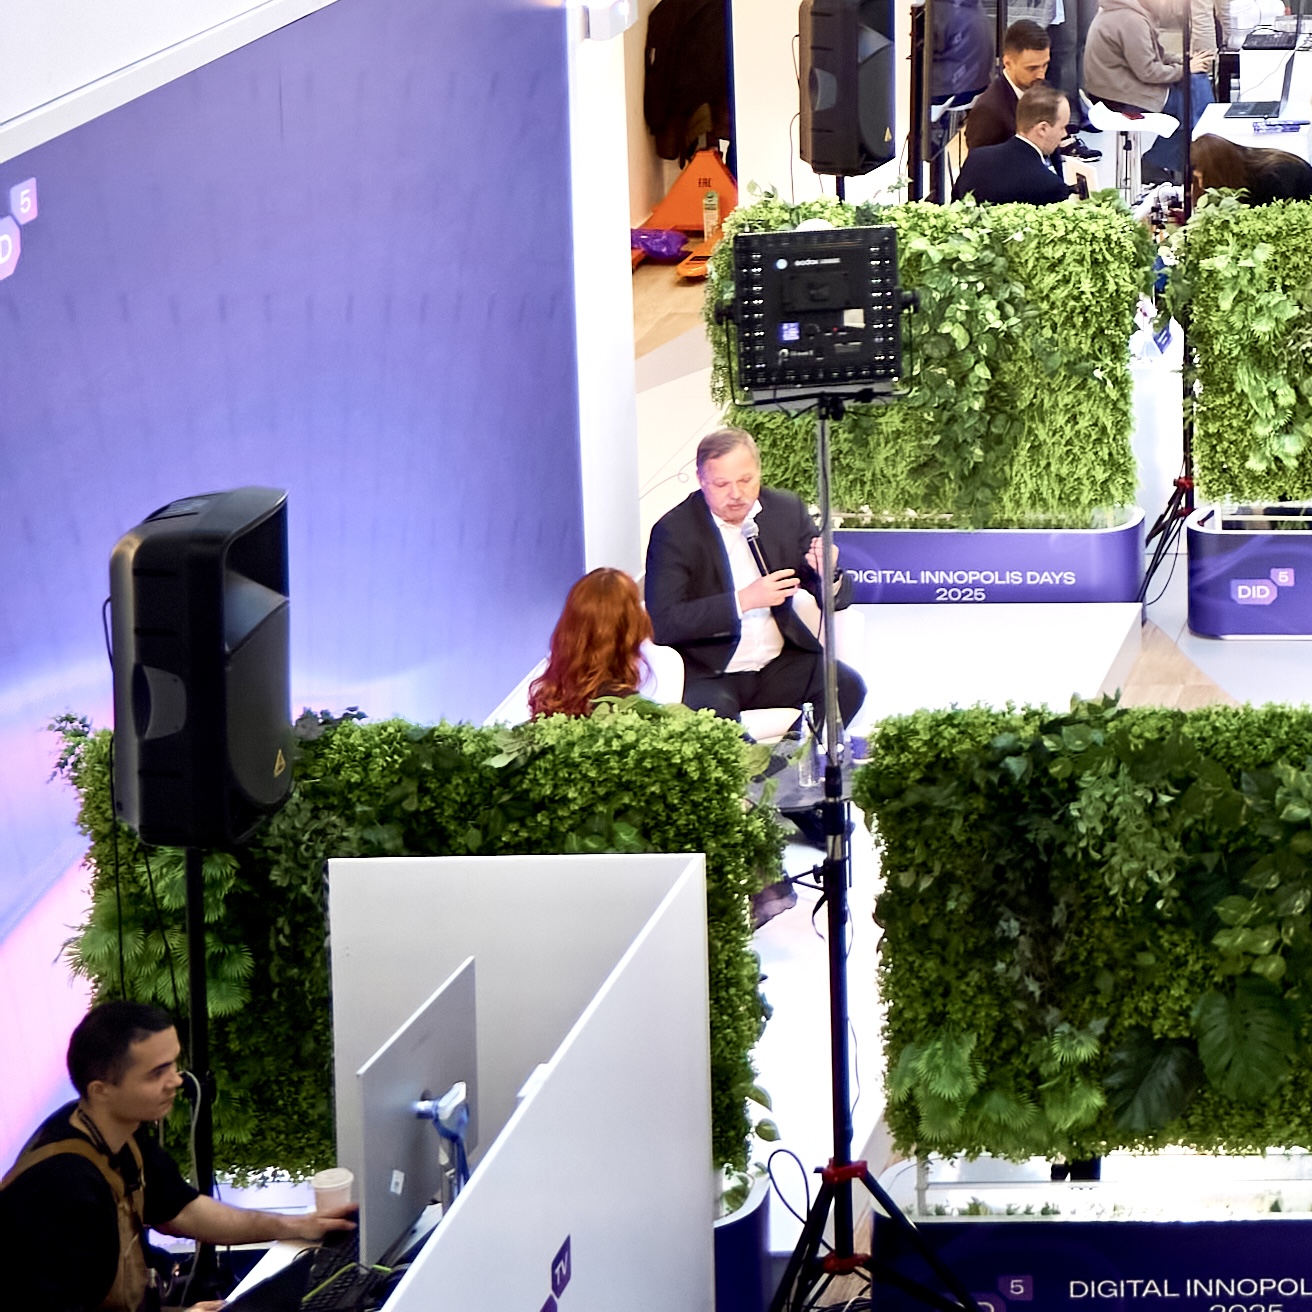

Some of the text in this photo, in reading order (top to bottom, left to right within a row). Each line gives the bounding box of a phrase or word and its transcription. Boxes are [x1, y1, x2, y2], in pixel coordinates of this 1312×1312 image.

[20, 189, 31, 214] 5
[920, 570, 1023, 585] INNOPOLIS
[1026, 571, 1076, 585] DAYS
[1278, 571, 1289, 583] 5
[935, 587, 986, 602] 2025
[1237, 585, 1270, 599] DID
[1009, 1279, 1024, 1295] 5
[1069, 1279, 1180, 1299] DIGITAL
